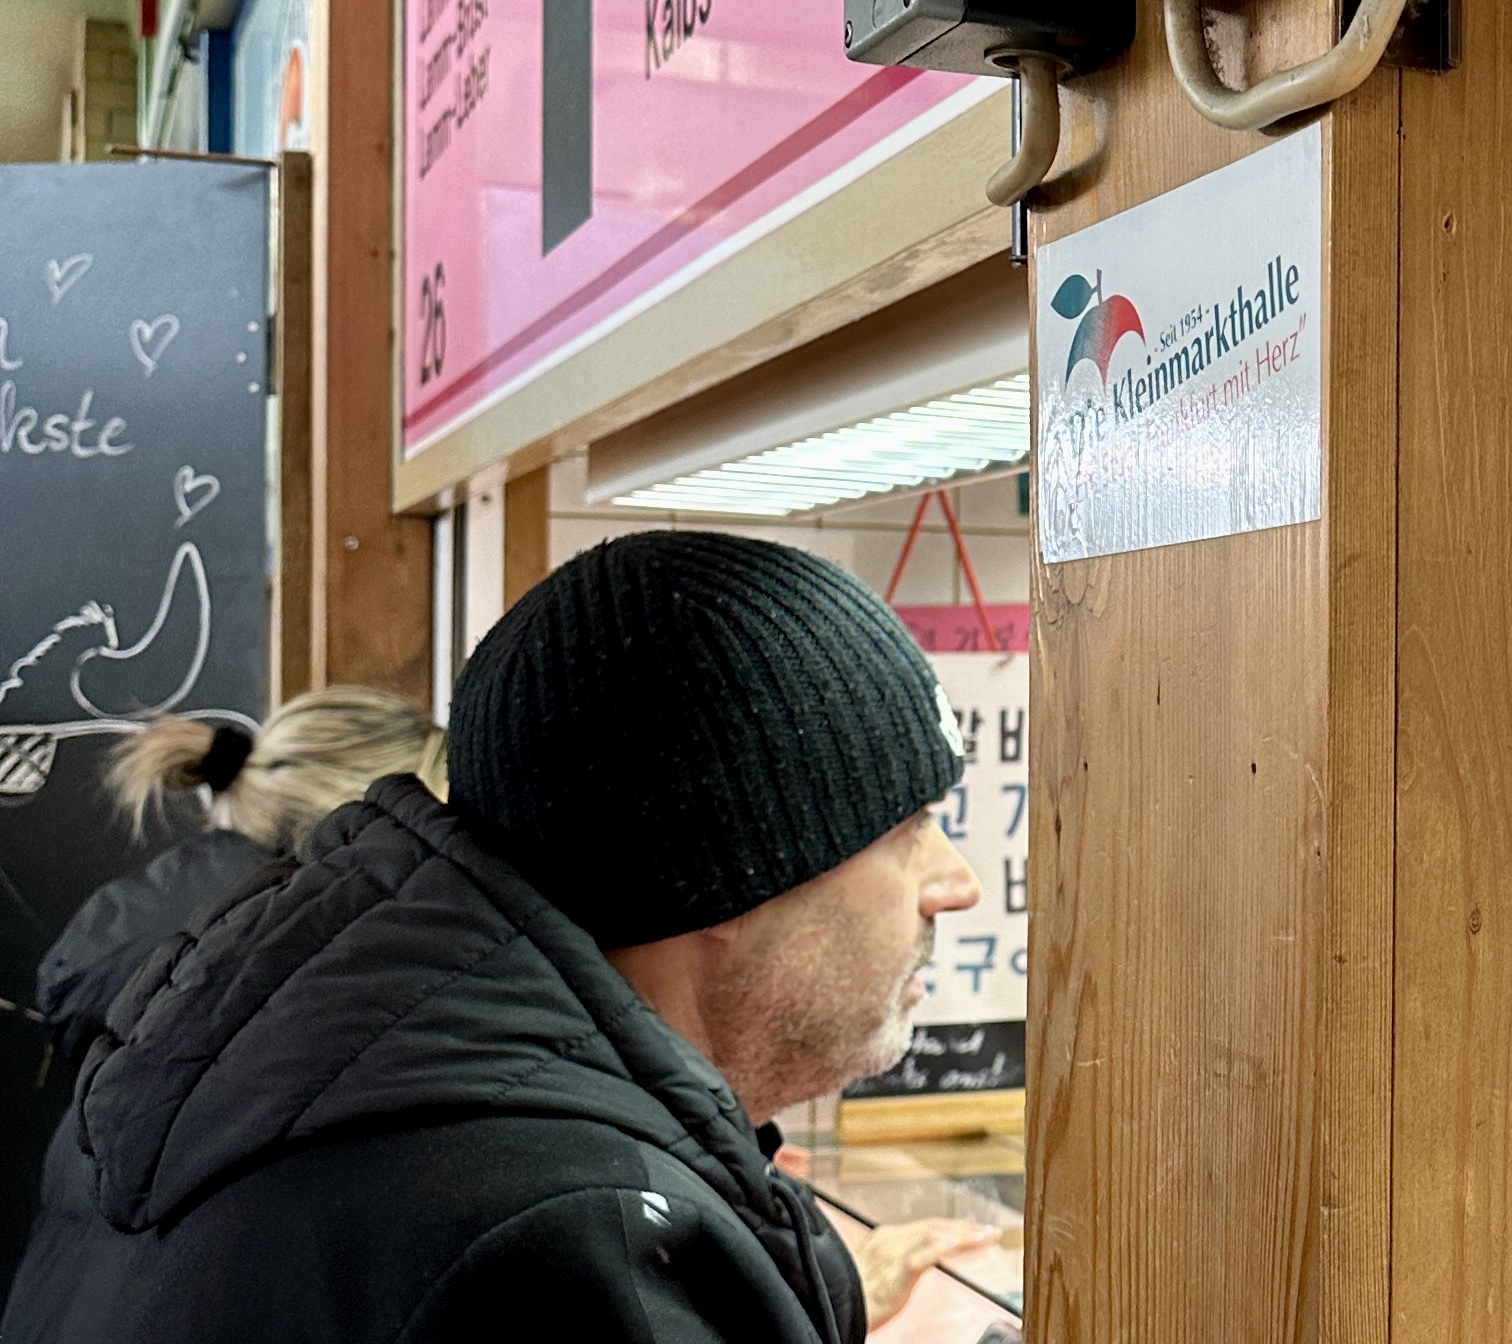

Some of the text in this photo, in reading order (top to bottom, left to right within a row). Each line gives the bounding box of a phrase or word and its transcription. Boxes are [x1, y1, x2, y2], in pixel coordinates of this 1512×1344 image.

[419, 260, 446, 388] 26
[1112, 255, 1300, 426] Kleinmarkthalle
[1159, 303, 1203, 353] Seit 1954
[1223, 360, 1251, 408] mit
